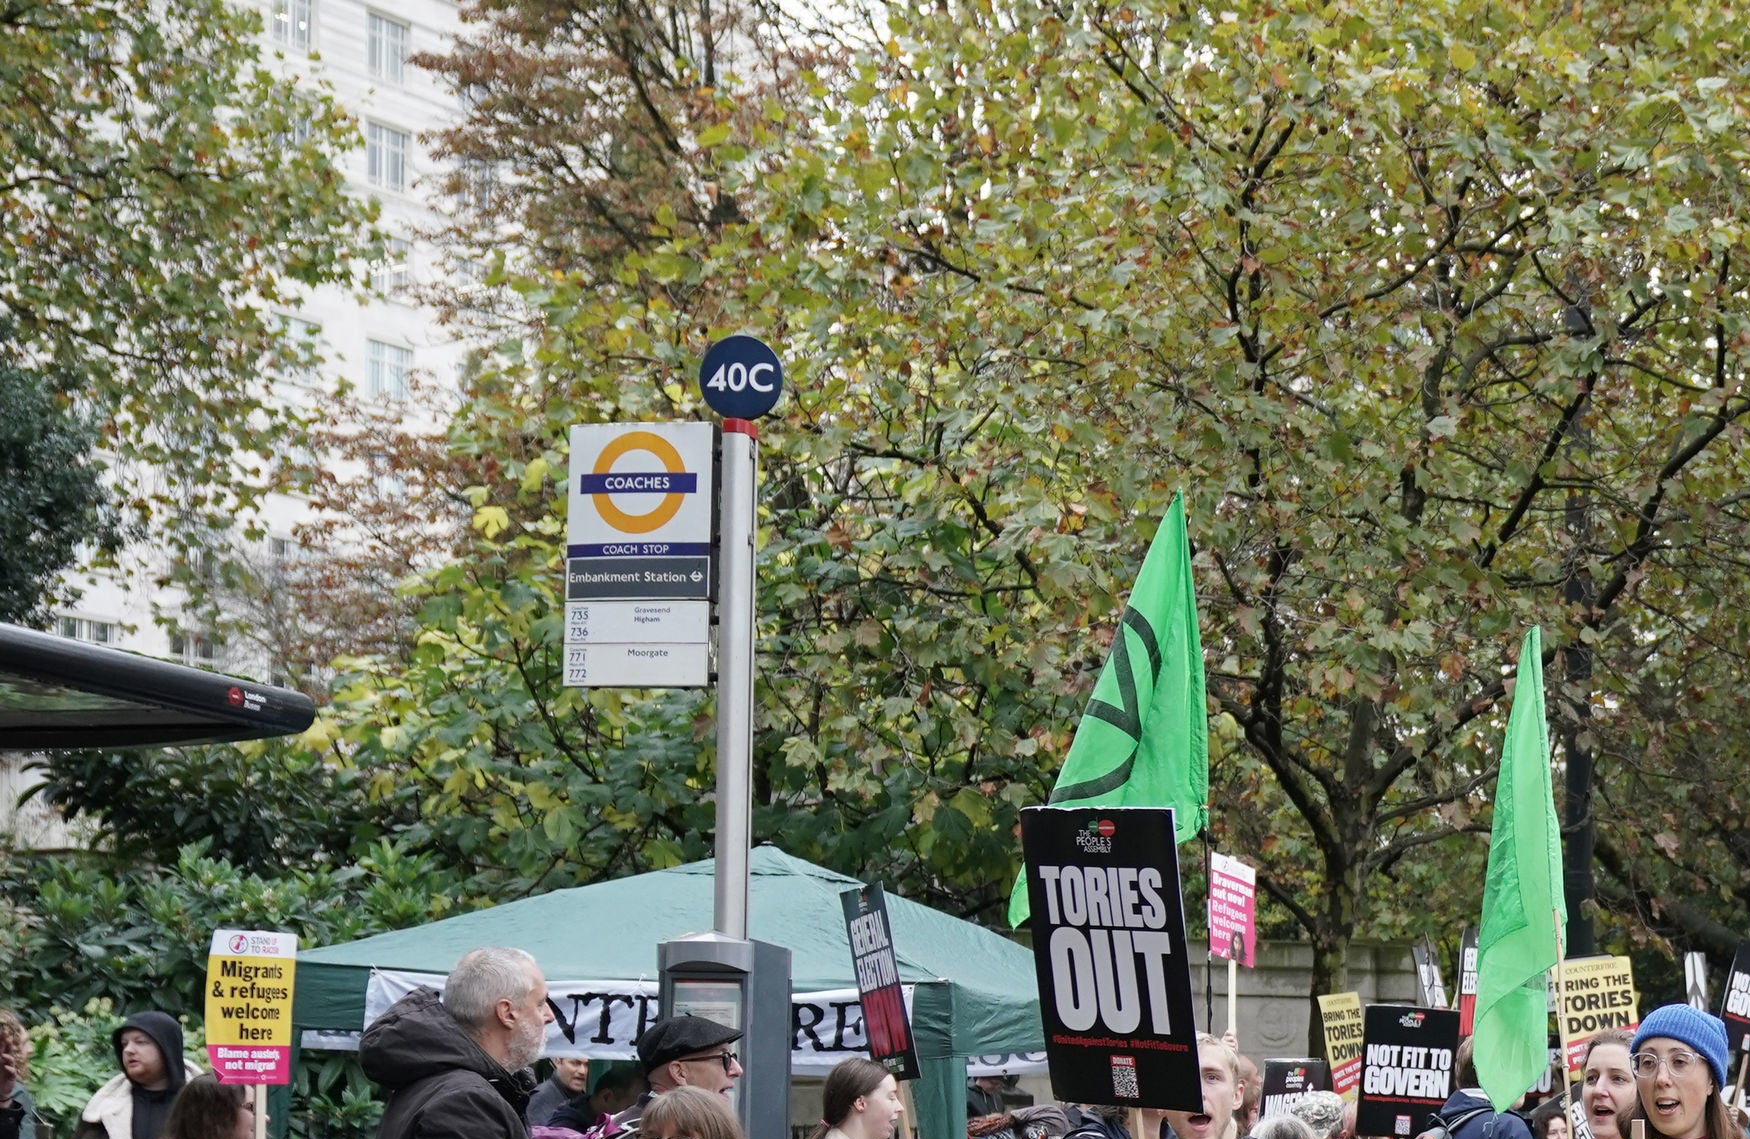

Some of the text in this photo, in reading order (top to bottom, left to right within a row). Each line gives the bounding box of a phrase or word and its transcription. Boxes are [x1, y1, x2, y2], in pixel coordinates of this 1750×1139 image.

[706, 362, 774, 392] 40C
[605, 476, 670, 490] COACHES
[602, 543, 669, 555] COACH STOP
[569, 570, 687, 584] Embankment Station
[571, 611, 589, 620] 735
[634, 606, 671, 614] Gravesend
[634, 616, 661, 624] Higham
[570, 627, 589, 637] 736
[569, 653, 586, 662] 771
[627, 648, 668, 658] Moorgate
[569, 669, 587, 678] 772
[1078, 829, 1091, 837] THE
[1083, 845, 1112, 853] ASSEMBLY
[1212, 871, 1253, 898] Braverman
[1039, 865, 1167, 929] TORIES
[1212, 887, 1226, 901] out
[1212, 900, 1248, 922] Refugees
[1212, 914, 1246, 934] welcome
[850, 910, 889, 958] GENERAL
[1212, 925, 1231, 941] here
[220, 960, 283, 982] Migrants
[856, 948, 897, 994] ELECTION
[1050, 926, 1171, 1036] OUT
[1605, 973, 1631, 987] THE
[212, 981, 288, 1003] & refugees
[1562, 990, 1633, 1014] TORIES
[221, 1002, 280, 1020] welcome
[1323, 1008, 1361, 1022] BRING THE
[863, 983, 908, 1058] NOW
[1567, 1011, 1631, 1034] DOWN
[239, 1023, 272, 1040] here
[1325, 1022, 1362, 1042] TORIES
[217, 1047, 249, 1059] Blame
[1331, 1042, 1362, 1061] DOWN
[1366, 1044, 1452, 1070] NOT FIT TO
[225, 1060, 242, 1070] not
[1112, 1056, 1133, 1066] DONATE
[1363, 1066, 1450, 1099] GOVERN
